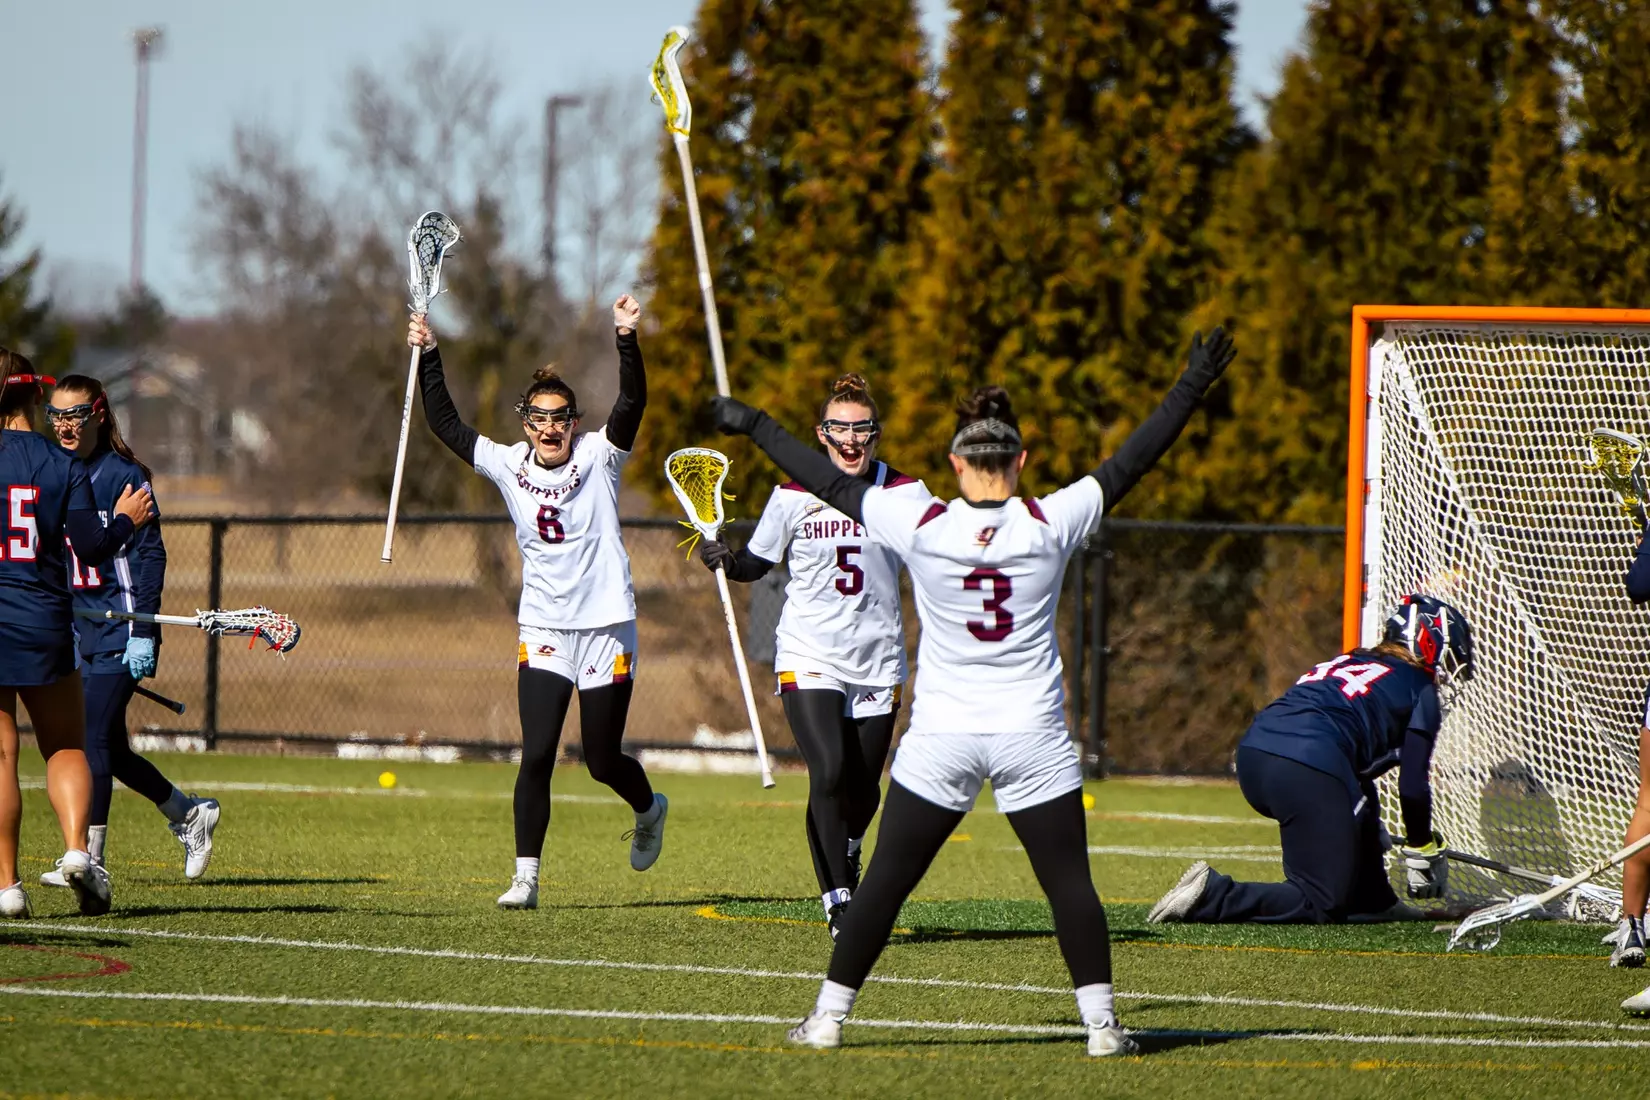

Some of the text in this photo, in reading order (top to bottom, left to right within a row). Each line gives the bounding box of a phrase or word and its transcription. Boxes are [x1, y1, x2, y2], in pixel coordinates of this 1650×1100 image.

[0, 485, 40, 562] 5
[536, 503, 566, 545] 6
[803, 518, 869, 540] CHIPPE
[834, 545, 865, 596] 5
[962, 566, 1014, 642] 3
